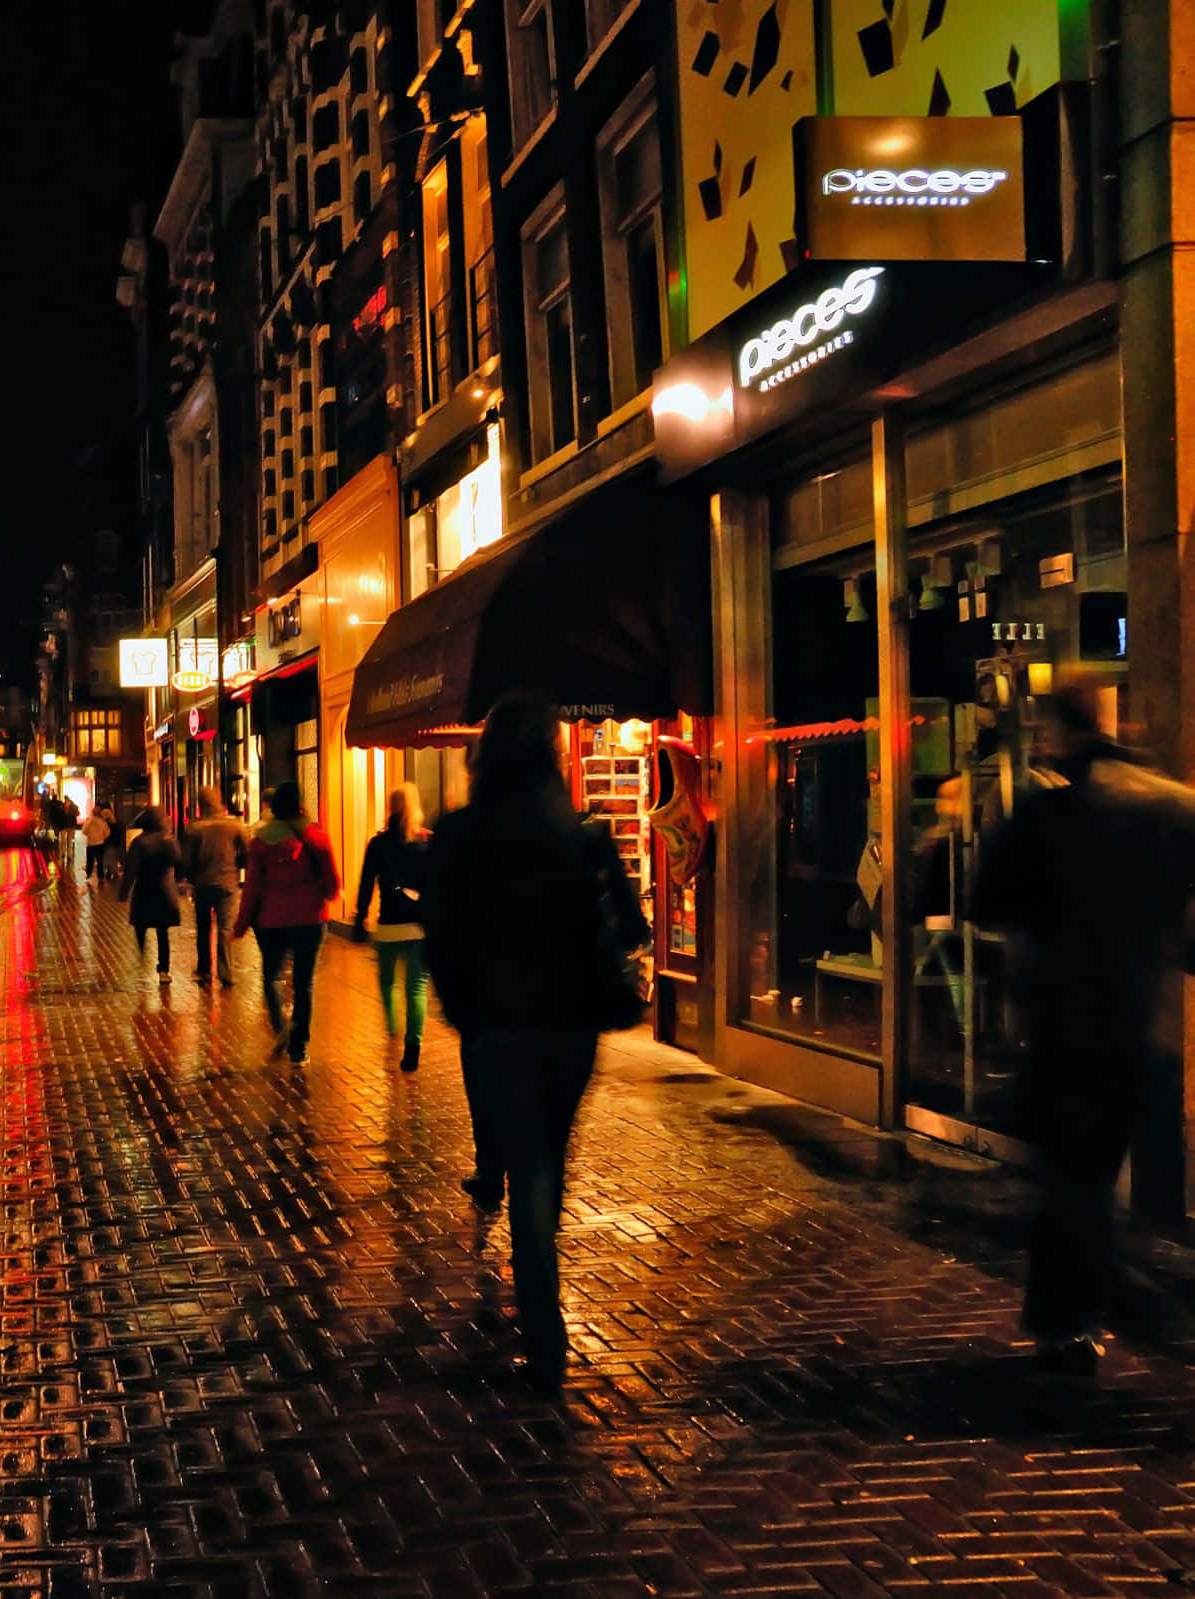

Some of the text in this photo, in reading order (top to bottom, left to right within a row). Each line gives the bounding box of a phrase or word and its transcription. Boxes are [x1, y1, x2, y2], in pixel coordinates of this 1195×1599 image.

[822, 168, 1007, 196] pieces
[740, 266, 886, 388] pieces
[759, 330, 855, 392] ACCESSORIES
